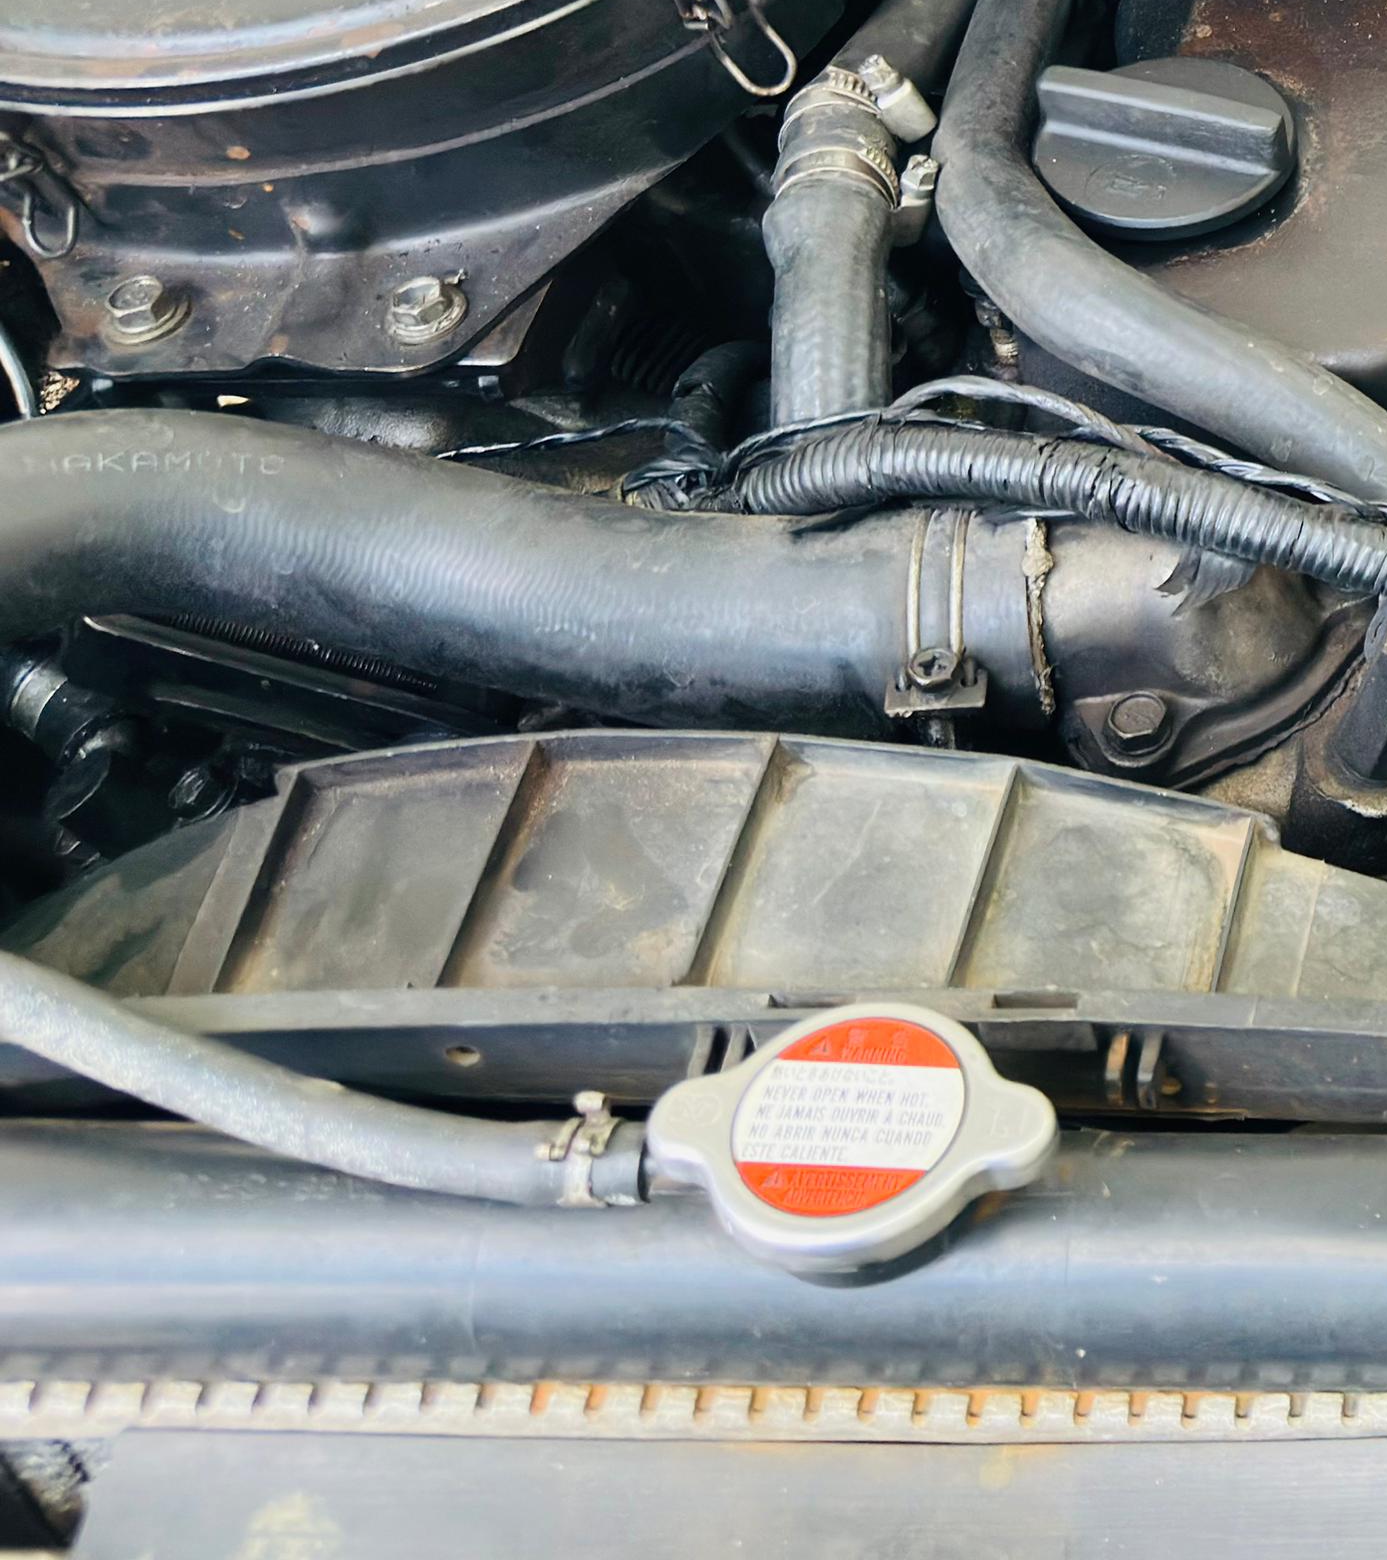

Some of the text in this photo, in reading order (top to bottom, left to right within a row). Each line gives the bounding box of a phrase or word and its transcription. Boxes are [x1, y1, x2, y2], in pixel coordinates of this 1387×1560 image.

[763, 1085, 809, 1102] NEVER
[813, 1087, 850, 1104] OPEN
[856, 1088, 898, 1107] WHEN
[756, 1103, 776, 1121] NE
[779, 1105, 827, 1122] JAMAIS
[831, 1106, 881, 1125] OUVRIR
[749, 1123, 933, 1147] NO ABRIR NUNCA CUANDO
